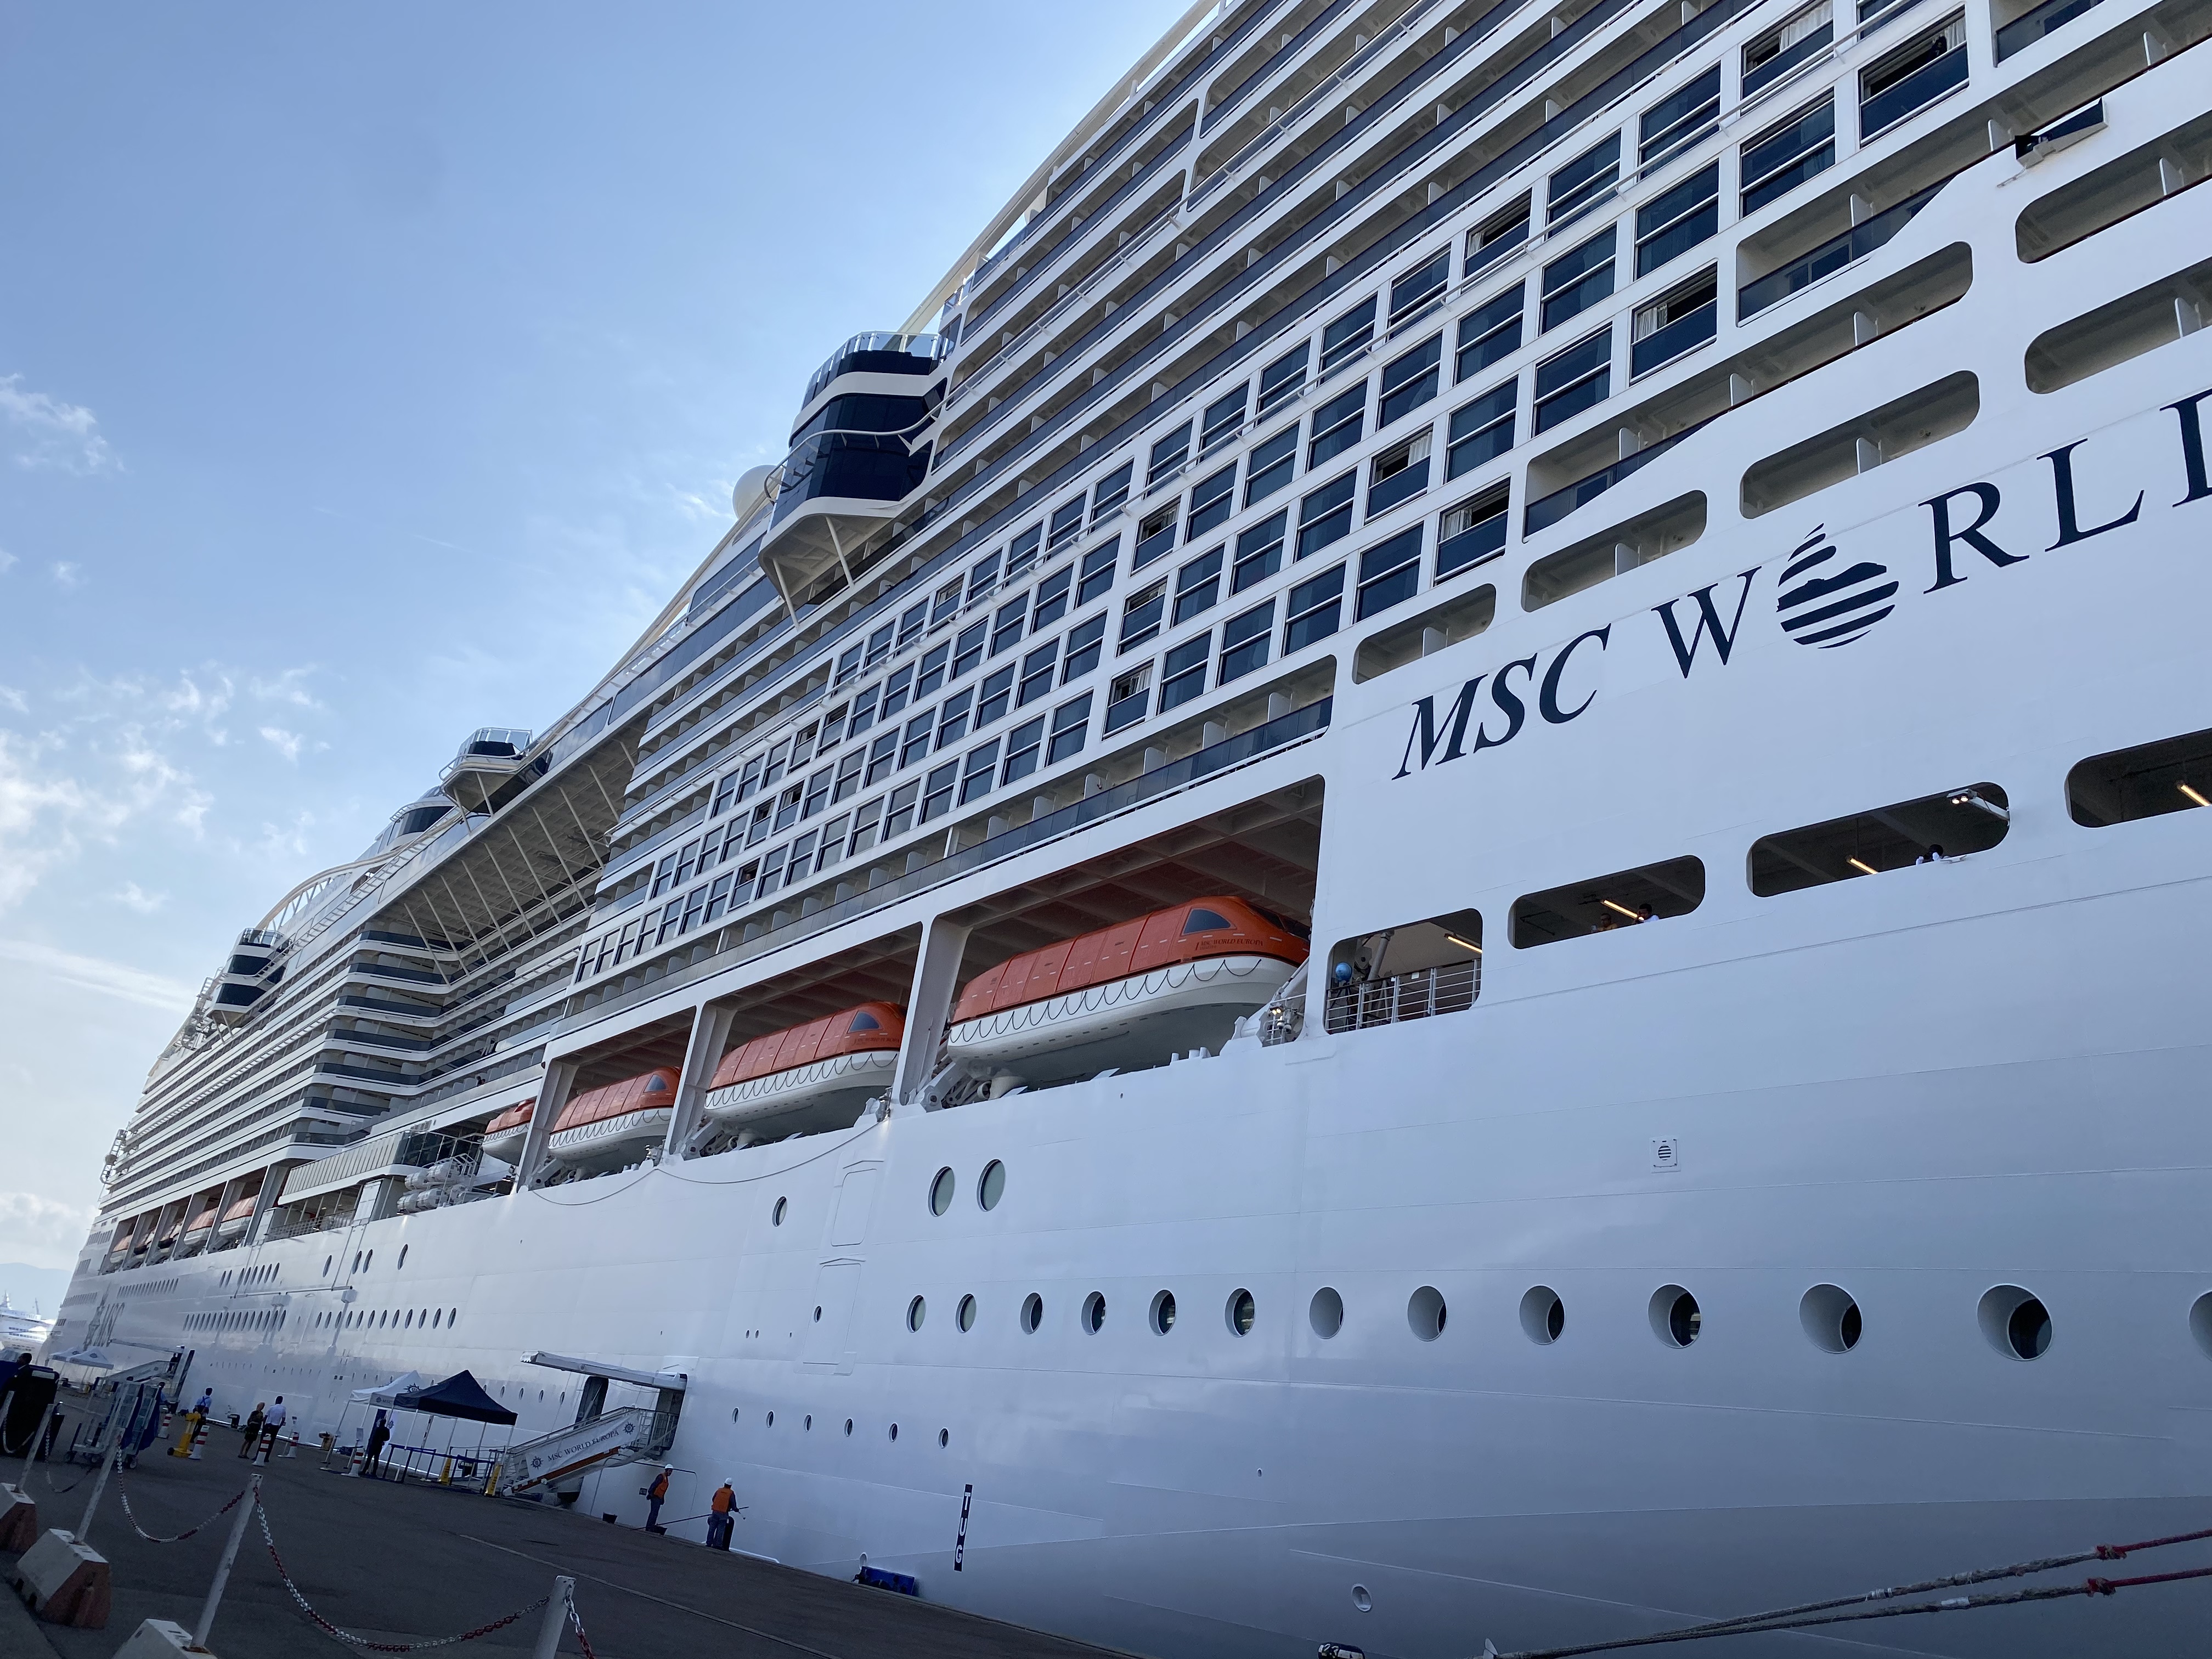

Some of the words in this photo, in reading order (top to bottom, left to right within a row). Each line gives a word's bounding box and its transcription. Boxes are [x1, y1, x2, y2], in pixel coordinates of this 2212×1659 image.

[1391, 623, 1611, 780] MSC
[547, 1451, 563, 1462] MSC
[564, 1441, 591, 1455] WORLD
[591, 1430, 619, 1444] EUROPA
[955, 1492, 971, 1564] TUG
